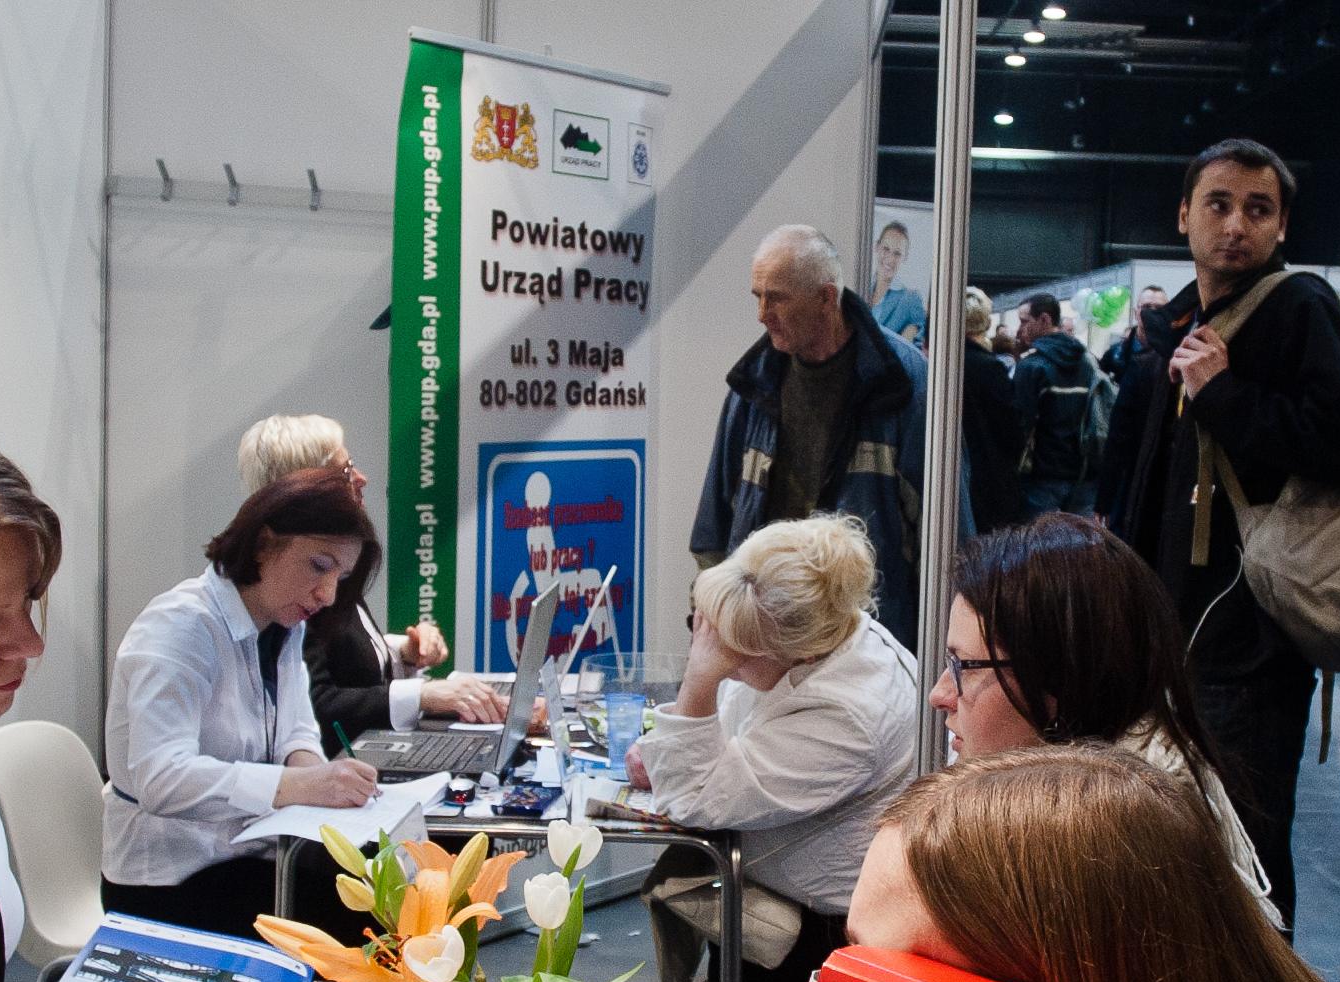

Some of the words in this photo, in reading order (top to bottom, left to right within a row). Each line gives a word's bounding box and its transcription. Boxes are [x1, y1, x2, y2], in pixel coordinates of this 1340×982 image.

[419, 85, 442, 280] www.pup.gda.pl
[491, 208, 645, 264] Powiatowy
[480, 260, 562, 305] Urząd
[574, 267, 649, 311] Pracy
[510, 338, 538, 367] ul.
[547, 339, 560, 366] 3
[568, 339, 625, 374] Maja
[418, 296, 441, 489] www.pup.gda.pl
[479, 379, 558, 407] 80-802
[565, 376, 647, 407] Gdańsk
[530, 540, 547, 571] lub
[551, 546, 584, 576] pracy
